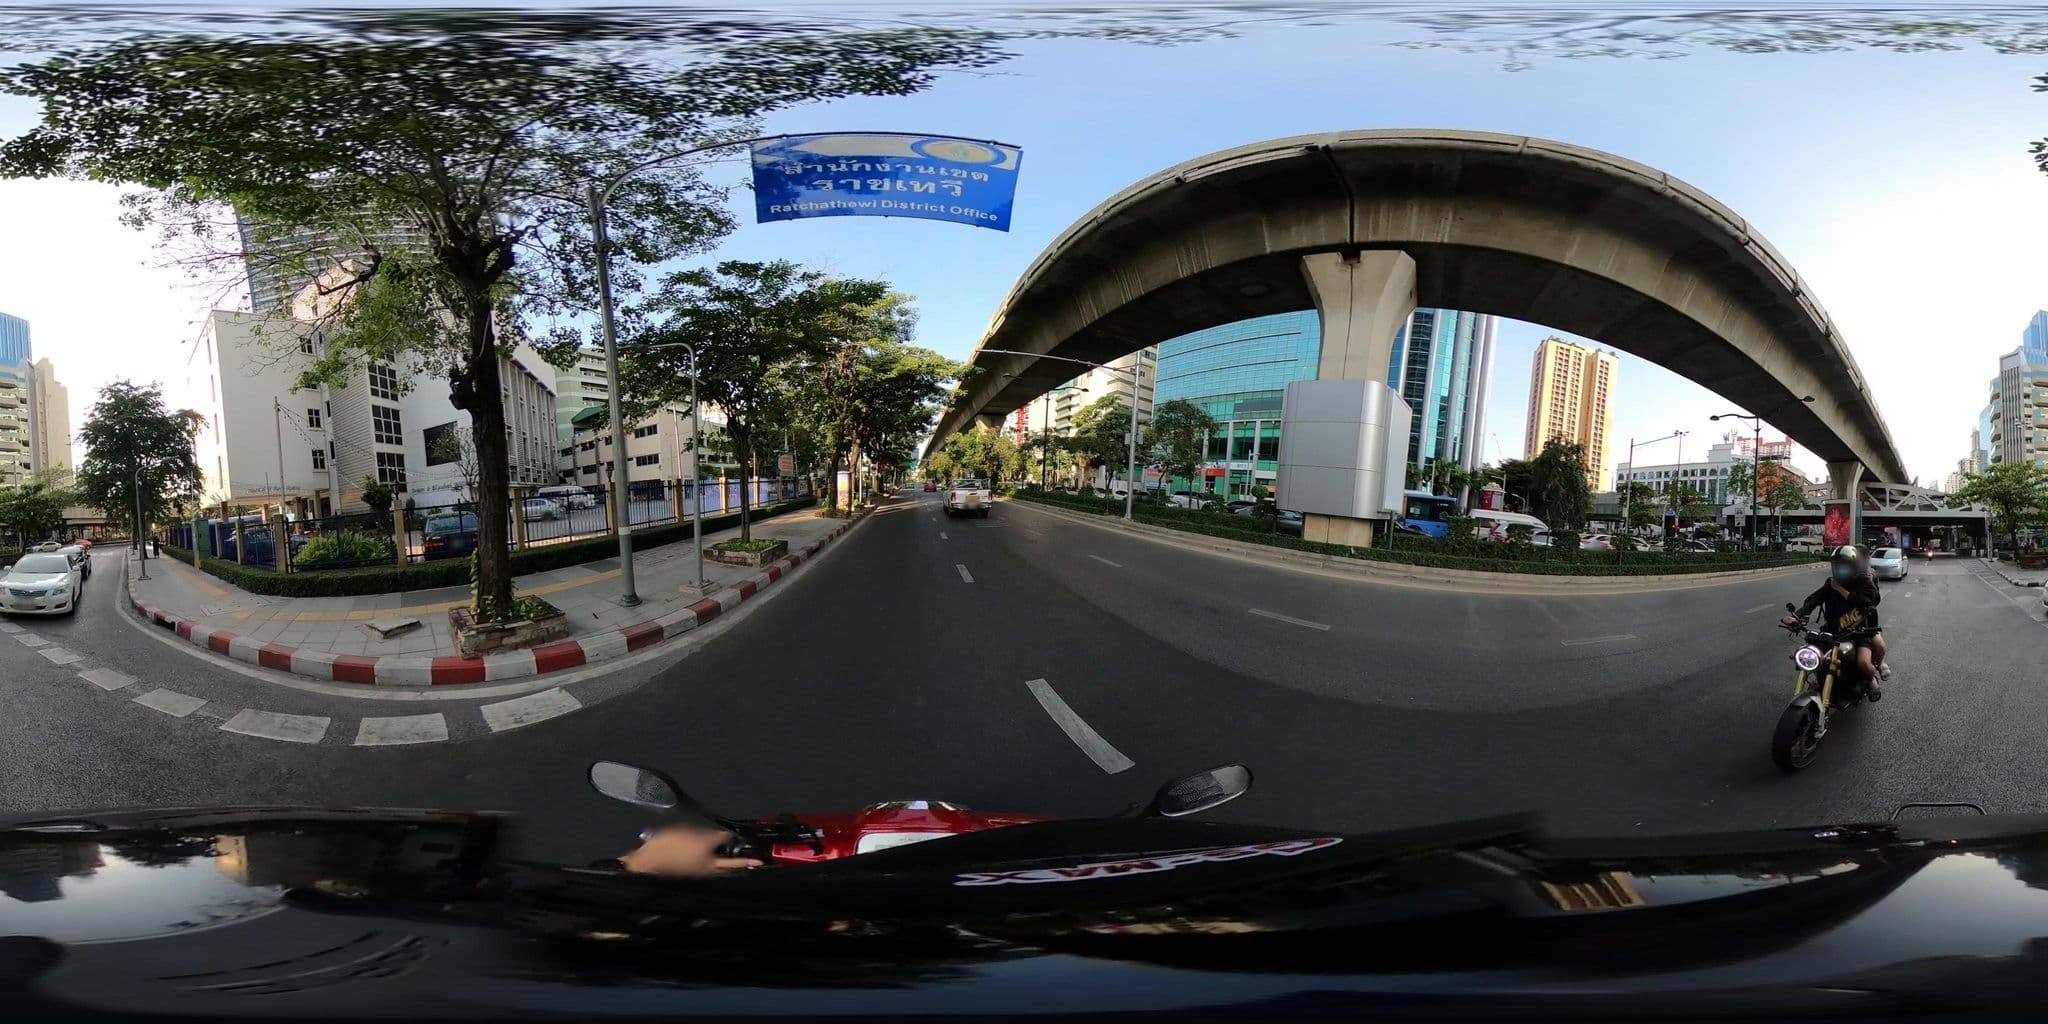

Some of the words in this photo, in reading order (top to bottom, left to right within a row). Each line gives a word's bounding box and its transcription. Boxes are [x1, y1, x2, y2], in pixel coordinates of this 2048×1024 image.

[784, 159, 989, 183] สำนักงานเขต
[813, 177, 964, 197] ราชเทวี
[770, 199, 877, 214] Ratchathewi
[881, 199, 945, 213] District
[950, 205, 998, 222] Office
